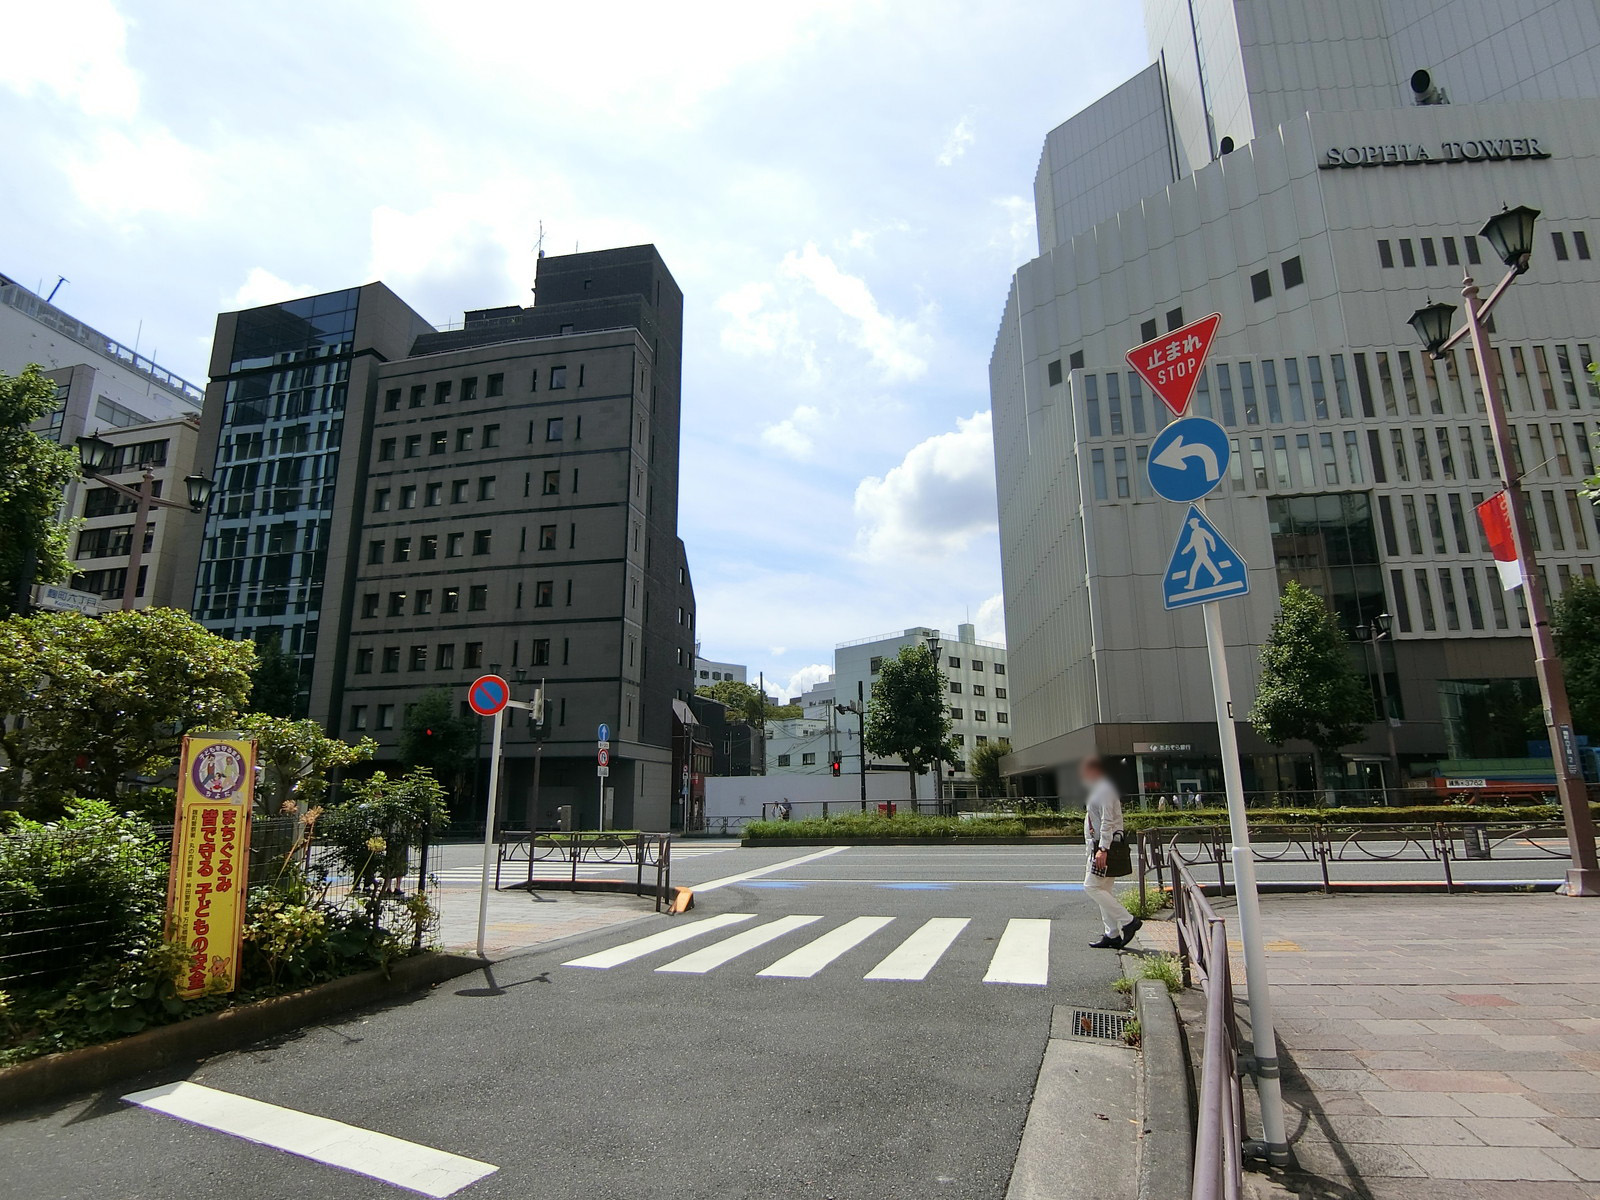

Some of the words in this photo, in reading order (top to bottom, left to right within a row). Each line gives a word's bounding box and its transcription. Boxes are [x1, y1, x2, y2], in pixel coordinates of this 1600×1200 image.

[1327, 143, 1432, 166] SOPHIA
[1441, 138, 1546, 160] TOWER
[1147, 334, 1202, 370] 止まれ
[1158, 358, 1196, 385] STOP
[197, 809, 219, 877] 皆で守る
[216, 809, 237, 893] まちぐるみ
[187, 882, 212, 991] 子どもの安全
